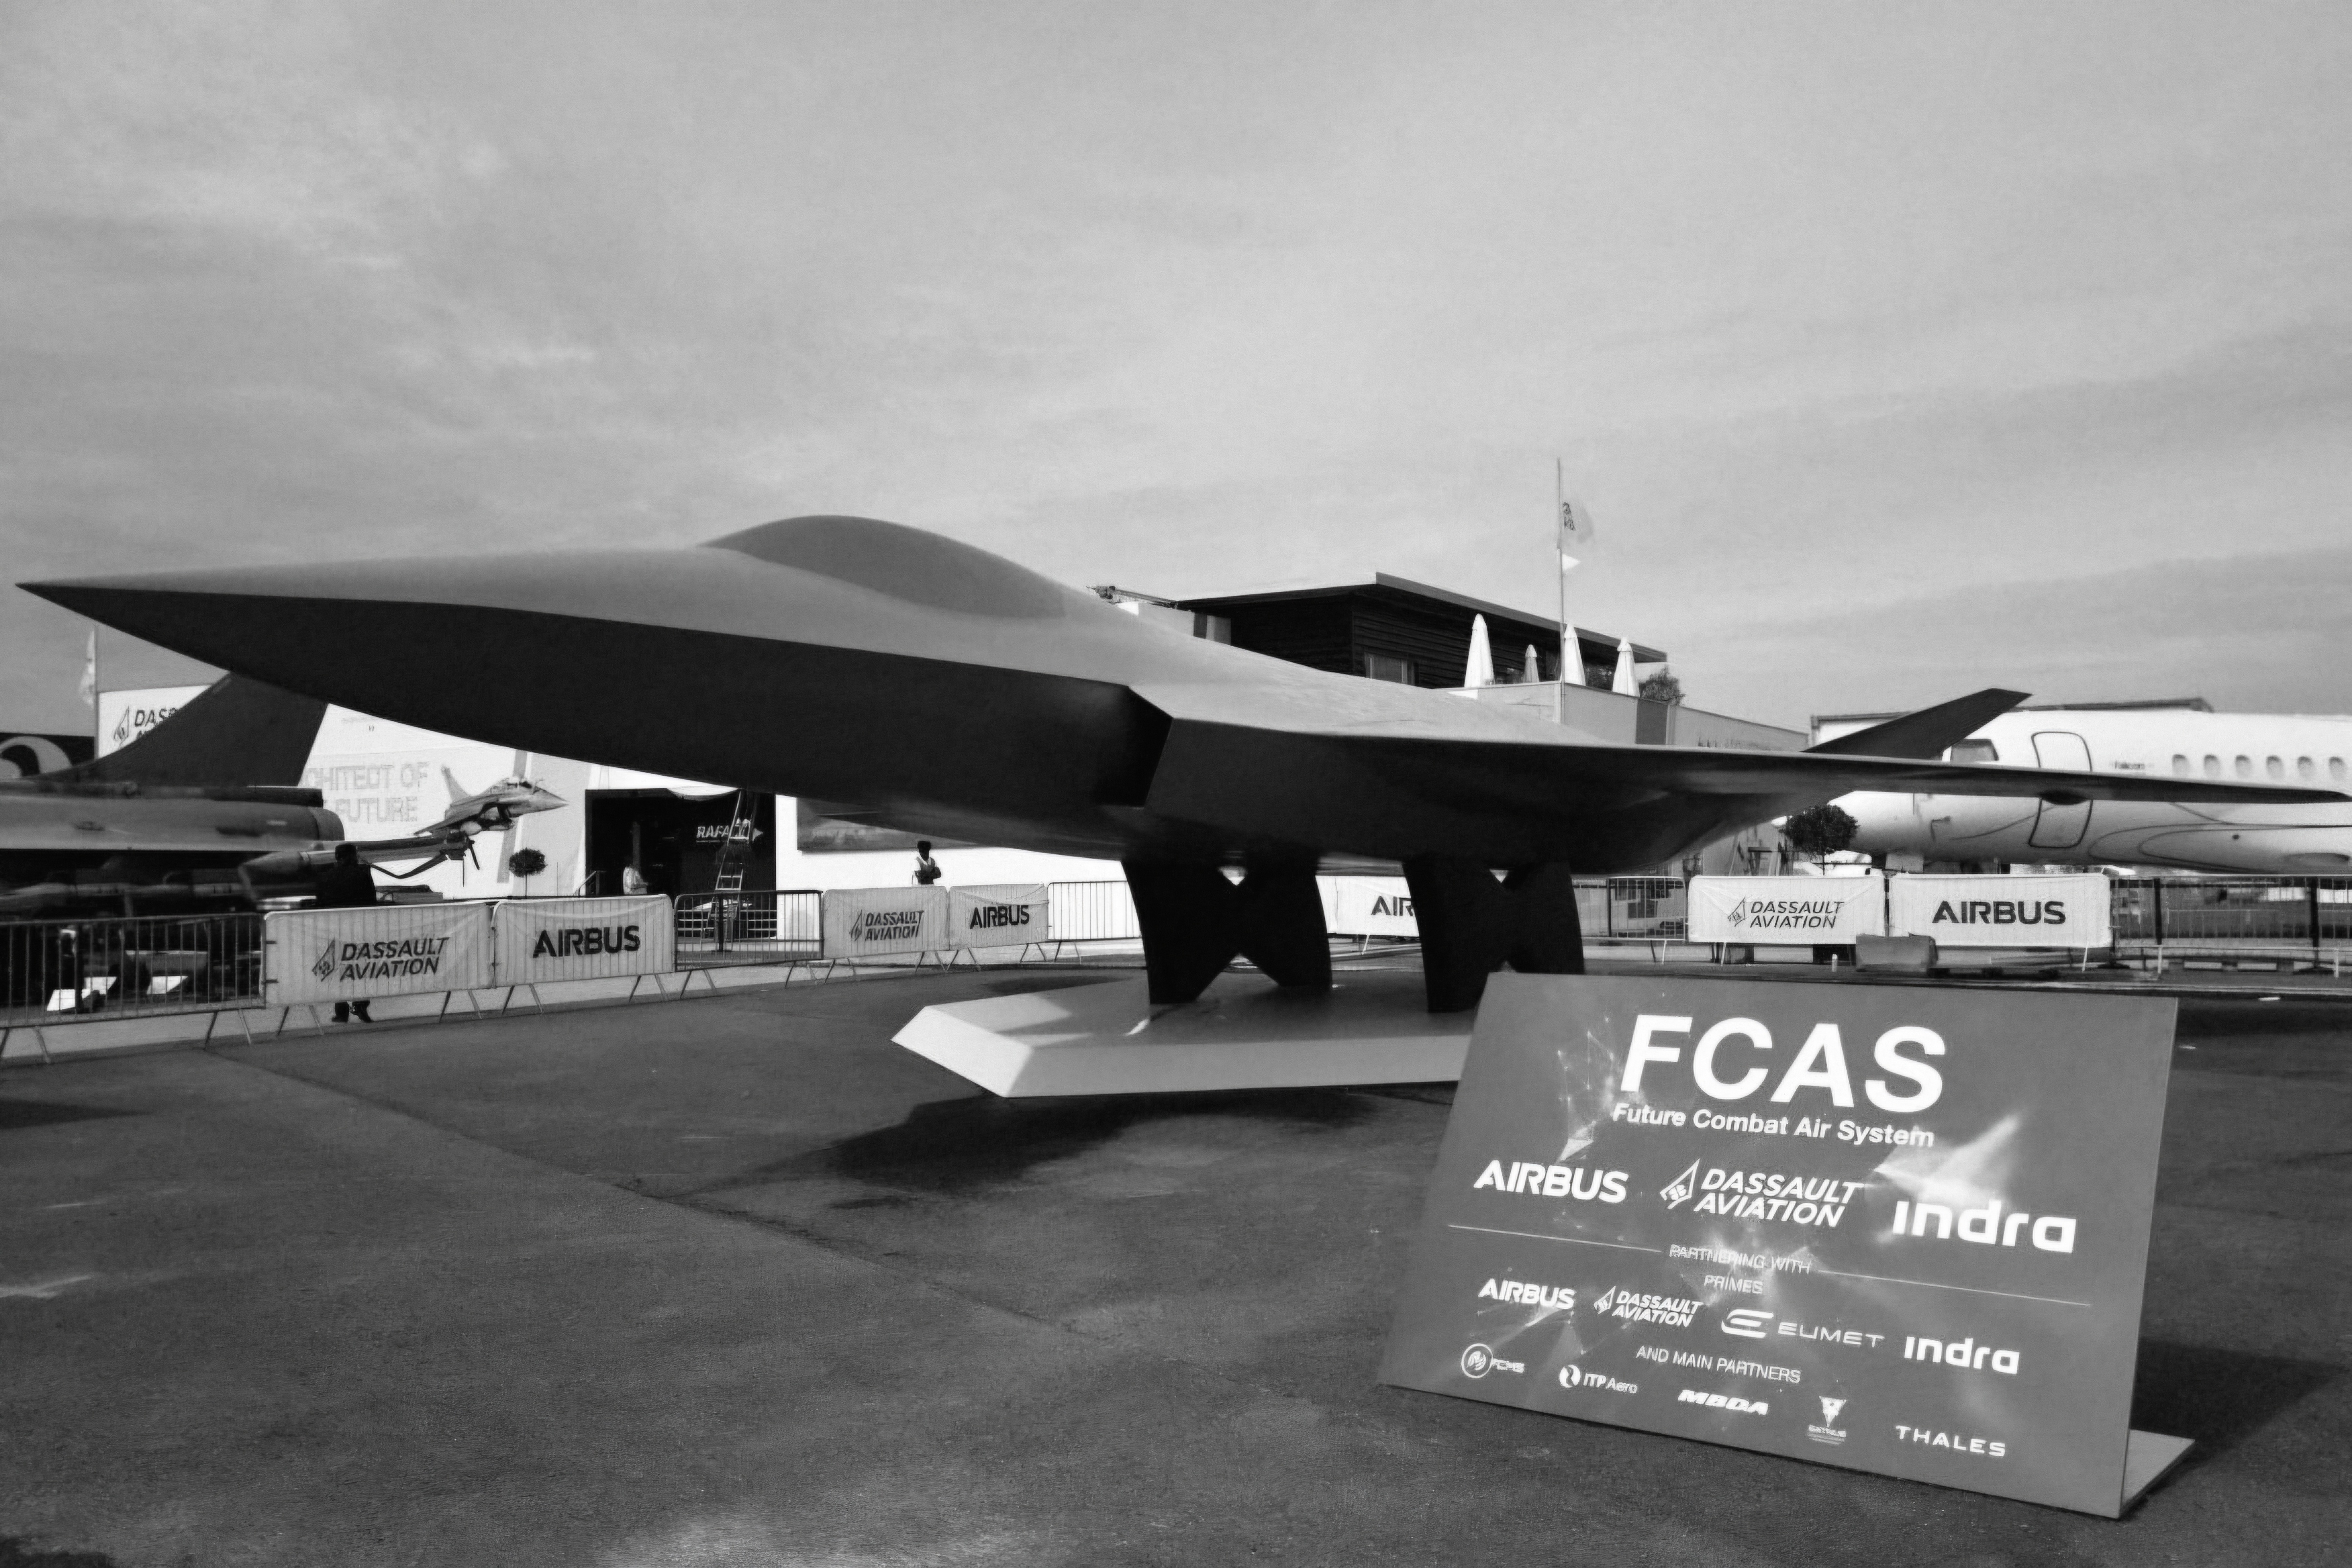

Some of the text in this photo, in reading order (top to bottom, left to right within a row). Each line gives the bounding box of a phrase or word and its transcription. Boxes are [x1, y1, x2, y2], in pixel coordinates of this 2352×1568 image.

[970, 905, 1030, 930] AIRBUS
[1371, 896, 1413, 916] AIR
[1750, 901, 1844, 914] DASSAULT
[1932, 901, 2066, 925] AIRBUS
[1749, 915, 1837, 929] AVIATION
[342, 937, 450, 961] DASSAULT
[533, 925, 641, 958] AIRBUS
[340, 957, 440, 982] AVIATION
[1620, 1014, 1946, 1113] FCAS
[1613, 1102, 1935, 1147] Future Combat Air System
[1473, 1159, 1630, 1203] AIRBUS
[1700, 1168, 1865, 1204] DASSAULT
[1693, 1192, 1846, 1228] AVIATION
[1892, 1199, 2077, 1254] indra
[1668, 1244, 1812, 1274] PARTNERING WITH
[1477, 1277, 1576, 1310] AIRBUS
[1704, 1274, 1764, 1295] PRIMES
[1611, 1305, 1694, 1327] AVIATION
[1616, 1291, 1705, 1316] DASSAULT
[1778, 1322, 1886, 1348] EUMET
[1636, 1345, 1802, 1384] AND MAIN PARTNERS
[1904, 1336, 2020, 1375] indra
[1677, 1389, 1769, 1416] MBDA
[1895, 1424, 2006, 1457] THALES
